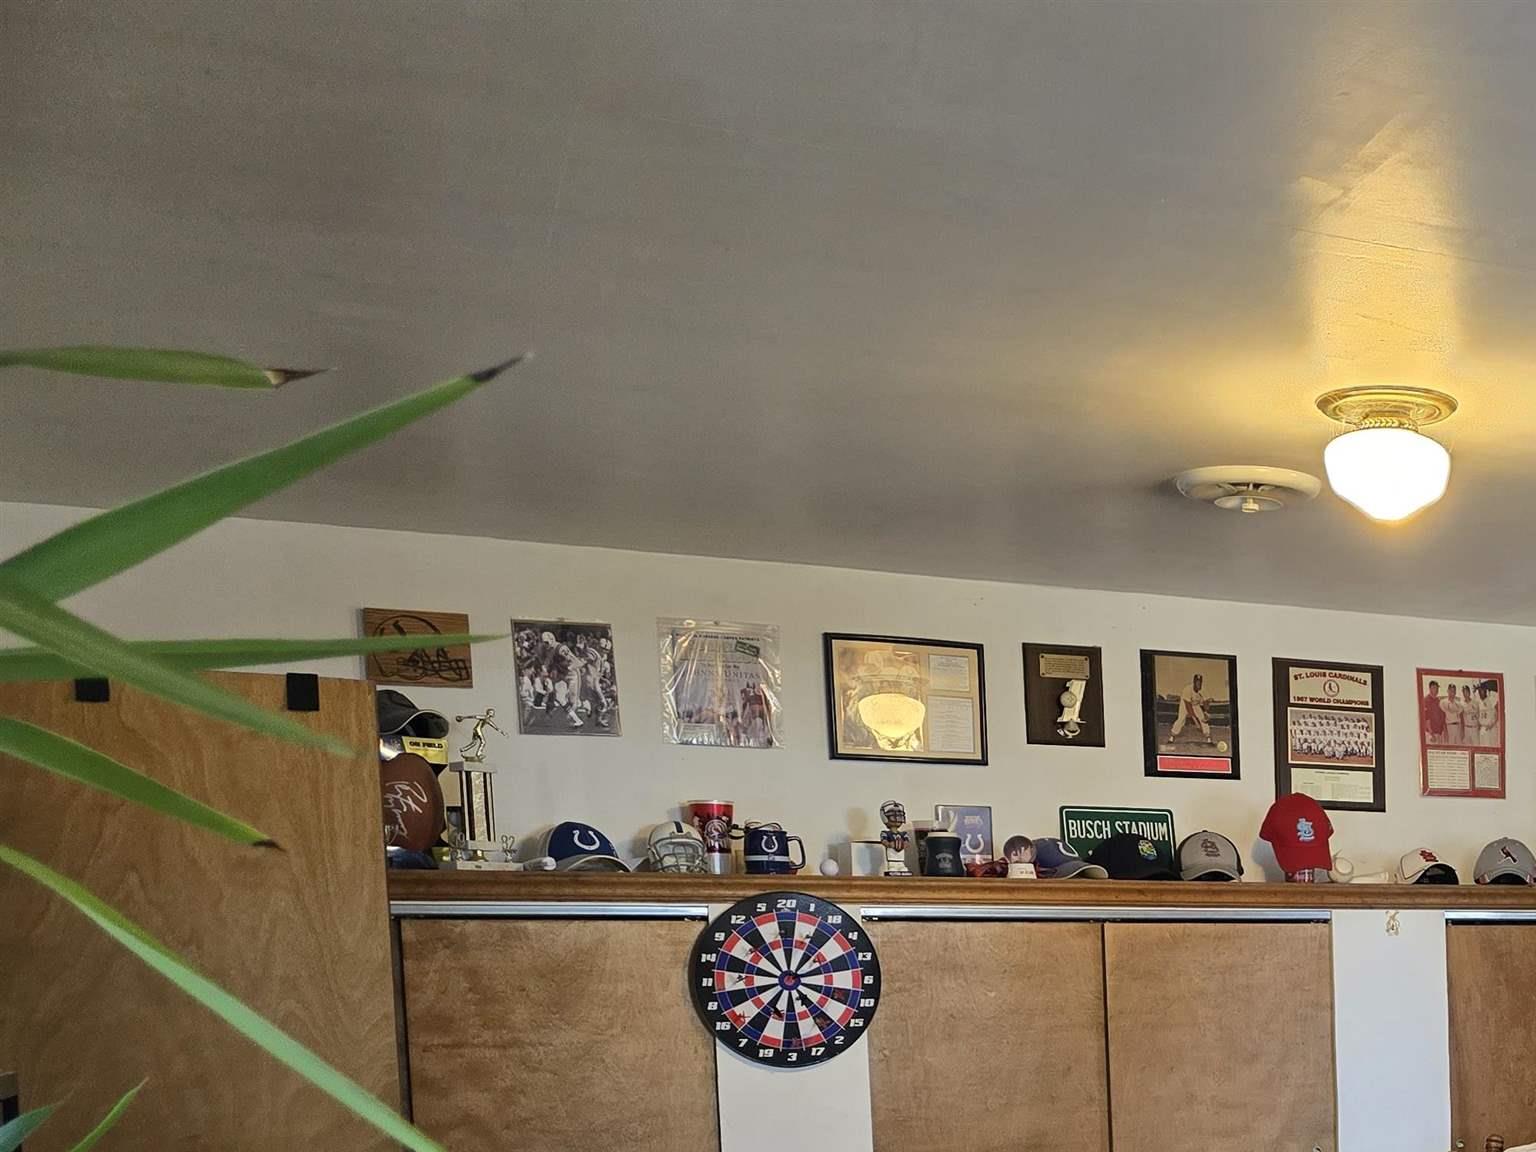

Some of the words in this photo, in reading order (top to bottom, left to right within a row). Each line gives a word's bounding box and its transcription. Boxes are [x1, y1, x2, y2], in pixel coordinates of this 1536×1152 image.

[1328, 672, 1367, 686] CARDINALS
[1332, 698, 1369, 707] CHAMPIONS
[1068, 819, 1112, 840] BUSCH
[1115, 821, 1169, 841] STADIUM
[756, 903, 767, 912] 5
[776, 899, 797, 909] 20
[809, 903, 816, 912] 1
[730, 914, 746, 924] 12
[827, 915, 842, 924] 18
[714, 932, 726, 942] 9
[848, 931, 859, 941] 4
[701, 953, 717, 963] 14
[857, 952, 872, 961] 13
[702, 977, 713, 987] 11
[863, 975, 874, 984] 6
[707, 1001, 718, 1010] 8
[859, 998, 875, 1008] 10
[715, 1021, 731, 1031] 16
[849, 1018, 864, 1027] 15
[738, 1038, 748, 1048] 7
[834, 1035, 845, 1045] 2
[758, 1048, 774, 1058] 19
[811, 1047, 825, 1056] 17
[787, 1052, 798, 1062] 3
